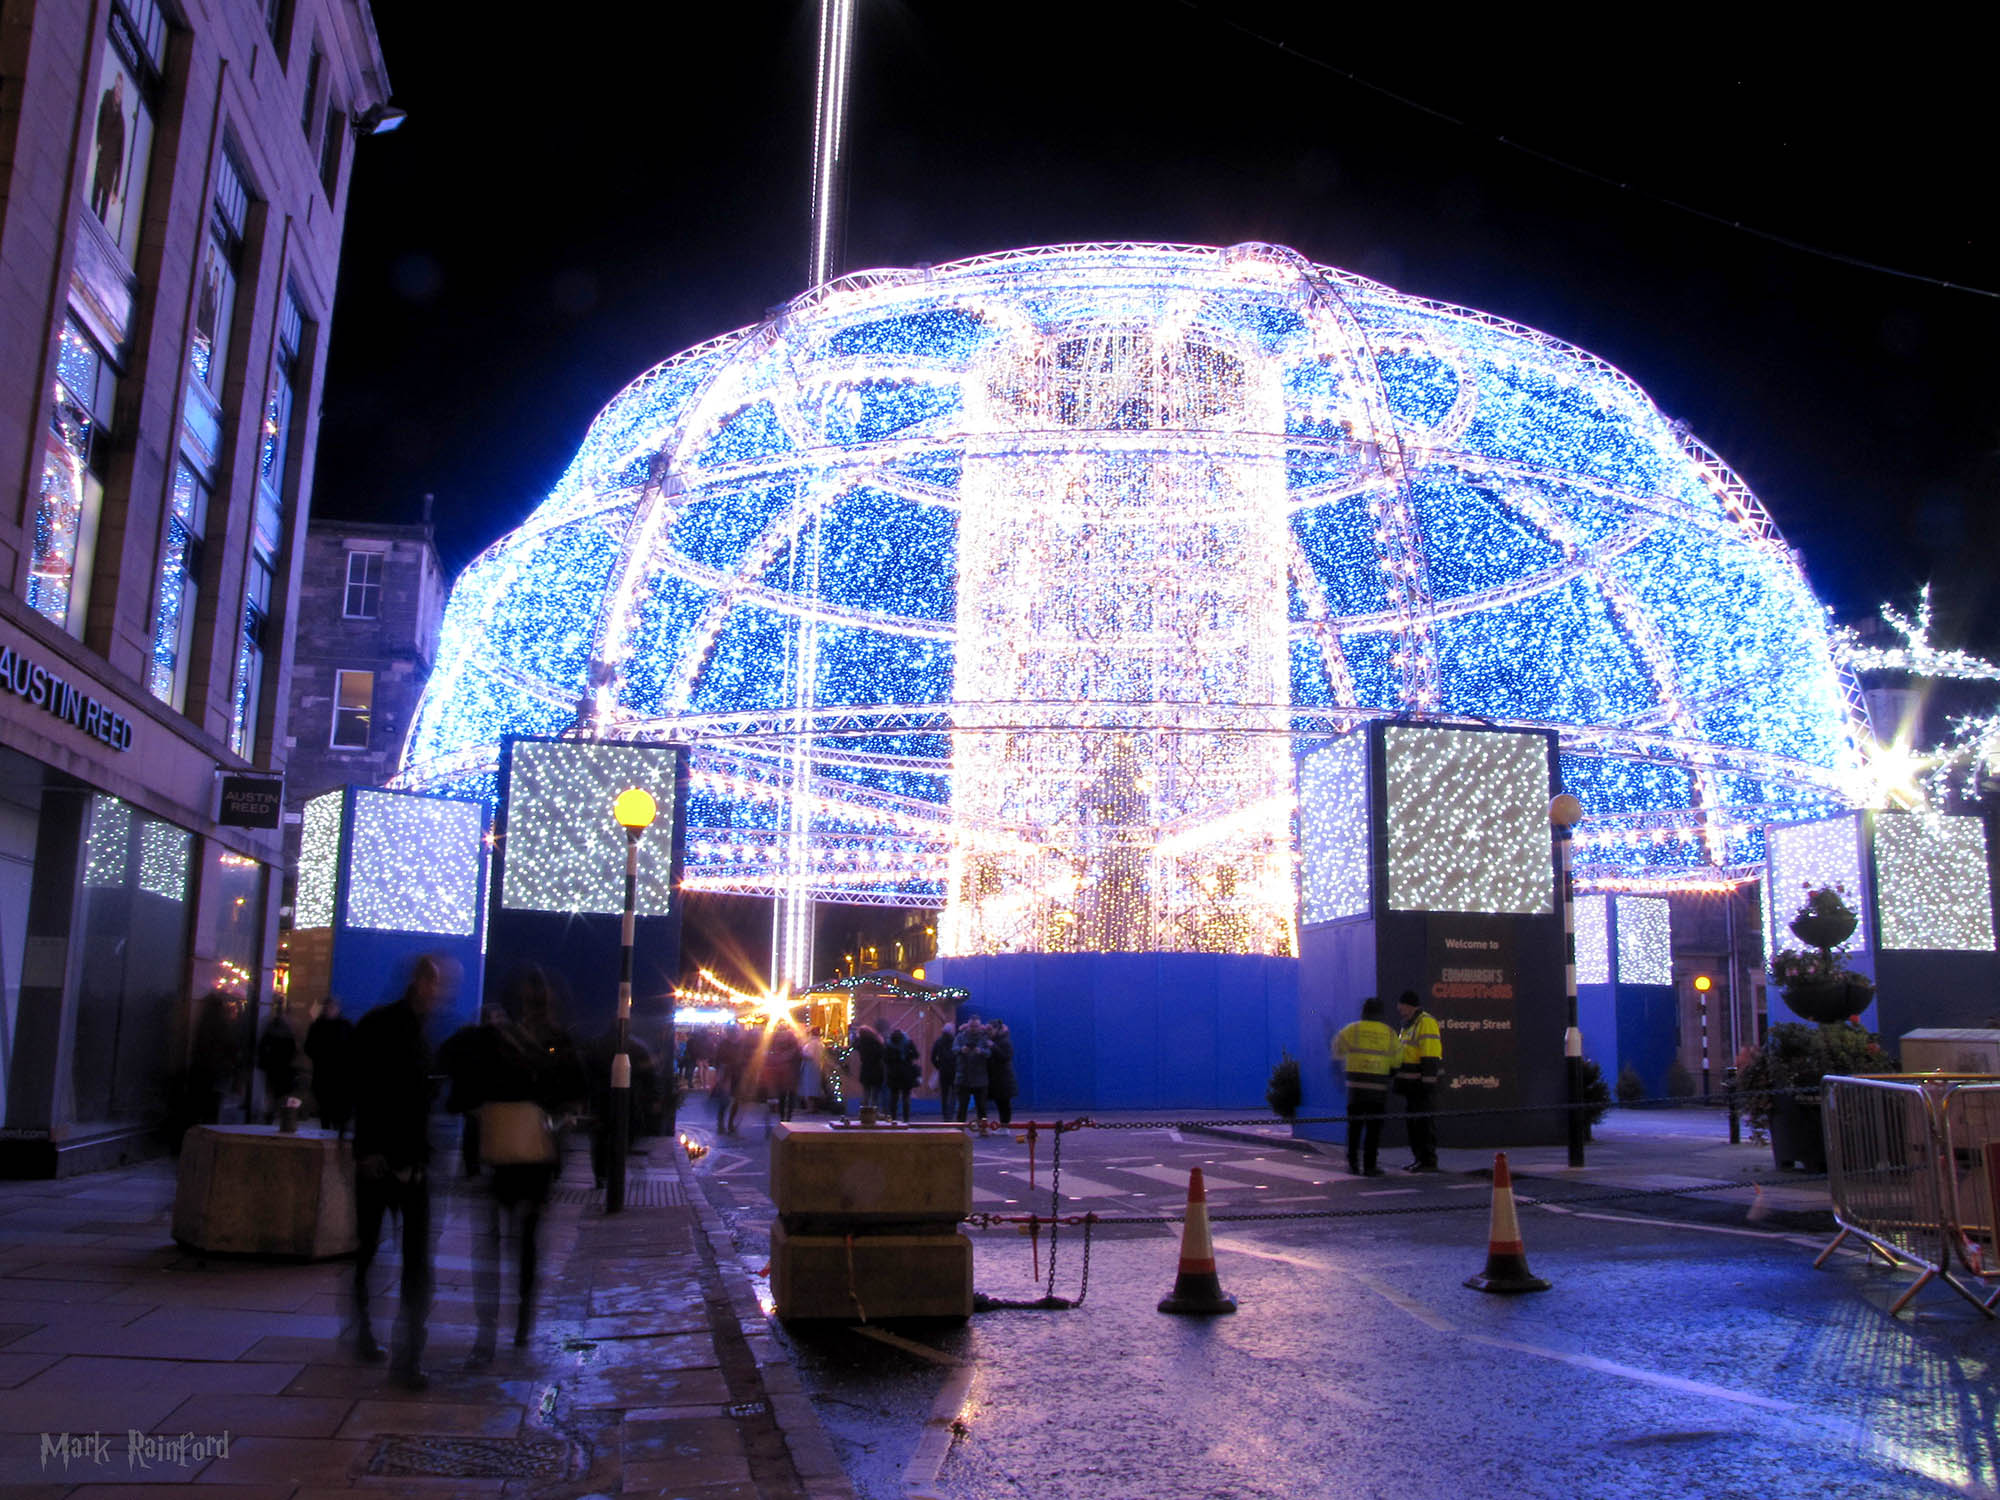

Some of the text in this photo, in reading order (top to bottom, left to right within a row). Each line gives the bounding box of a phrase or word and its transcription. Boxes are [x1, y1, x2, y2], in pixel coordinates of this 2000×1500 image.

[0, 646, 133, 752] AUSTIN REED
[225, 791, 279, 804] AUSTIN
[231, 802, 270, 814] REED
[1445, 938, 1499, 949] Welcome to
[1447, 1019, 1481, 1031] George
[1482, 1019, 1511, 1030] Street
